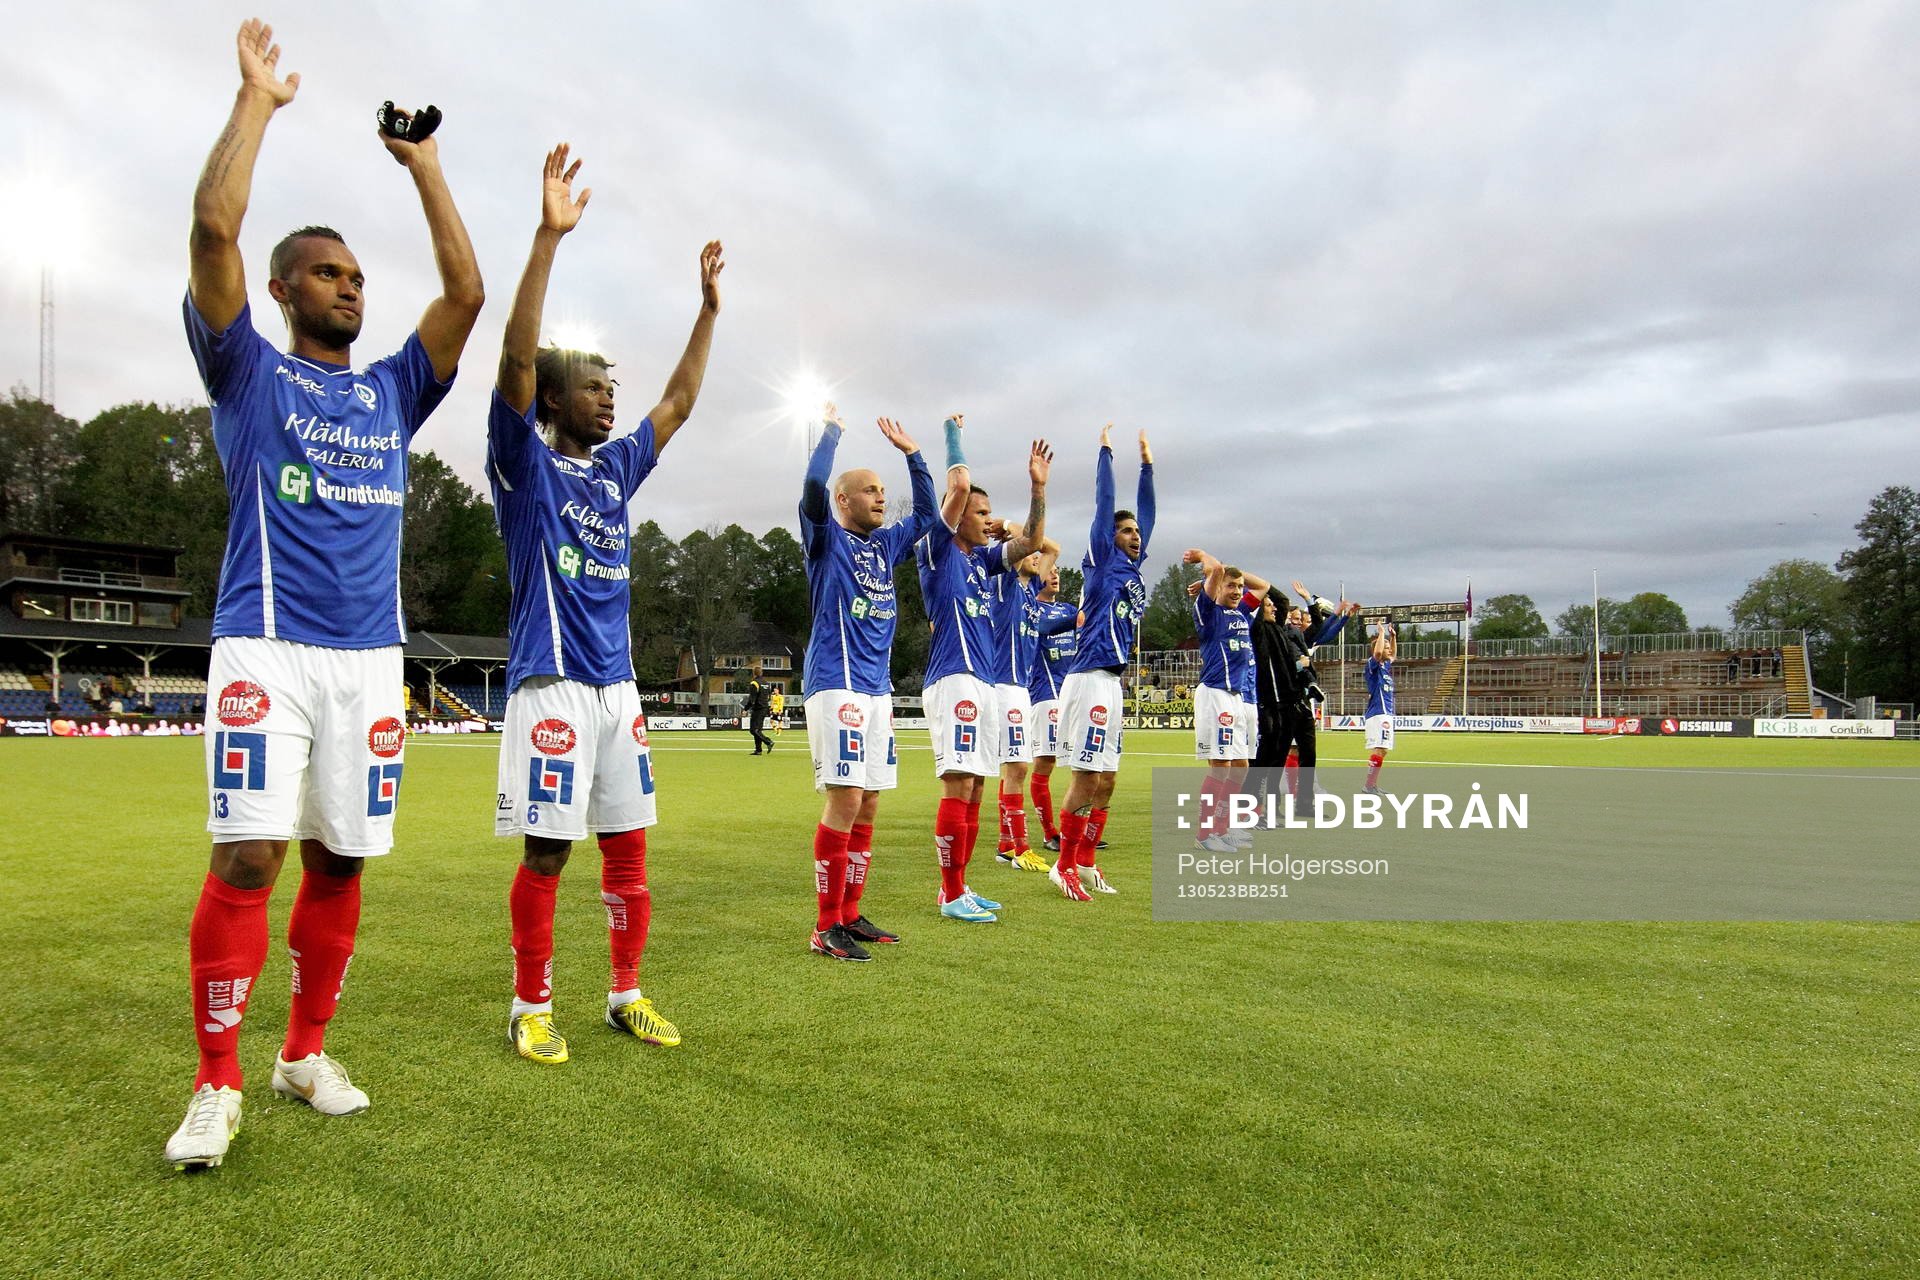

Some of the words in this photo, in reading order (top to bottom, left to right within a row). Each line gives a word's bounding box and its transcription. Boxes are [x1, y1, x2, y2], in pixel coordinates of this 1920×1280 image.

[284, 412, 401, 451] Klädhuset
[221, 694, 259, 712] mix
[219, 709, 258, 720] MEGAPOL
[709, 717, 733, 726] uhlsport
[1141, 716, 1197, 729] XL-BY
[1359, 716, 1423, 729] Mjöhus
[1454, 717, 1524, 731] Myresjöhus
[1679, 720, 1733, 732] ASSALUB
[1761, 721, 1799, 734] RGB
[1830, 724, 1874, 734] ConLink
[373, 729, 401, 745] mix
[537, 728, 570, 745] mix
[1009, 747, 1020, 757] 24
[1079, 750, 1094, 763] 25
[1218, 745, 1225, 755] 5
[836, 762, 850, 777] 10
[214, 792, 230, 819] 13
[527, 804, 539, 825] 6
[208, 981, 231, 1008] INTER
